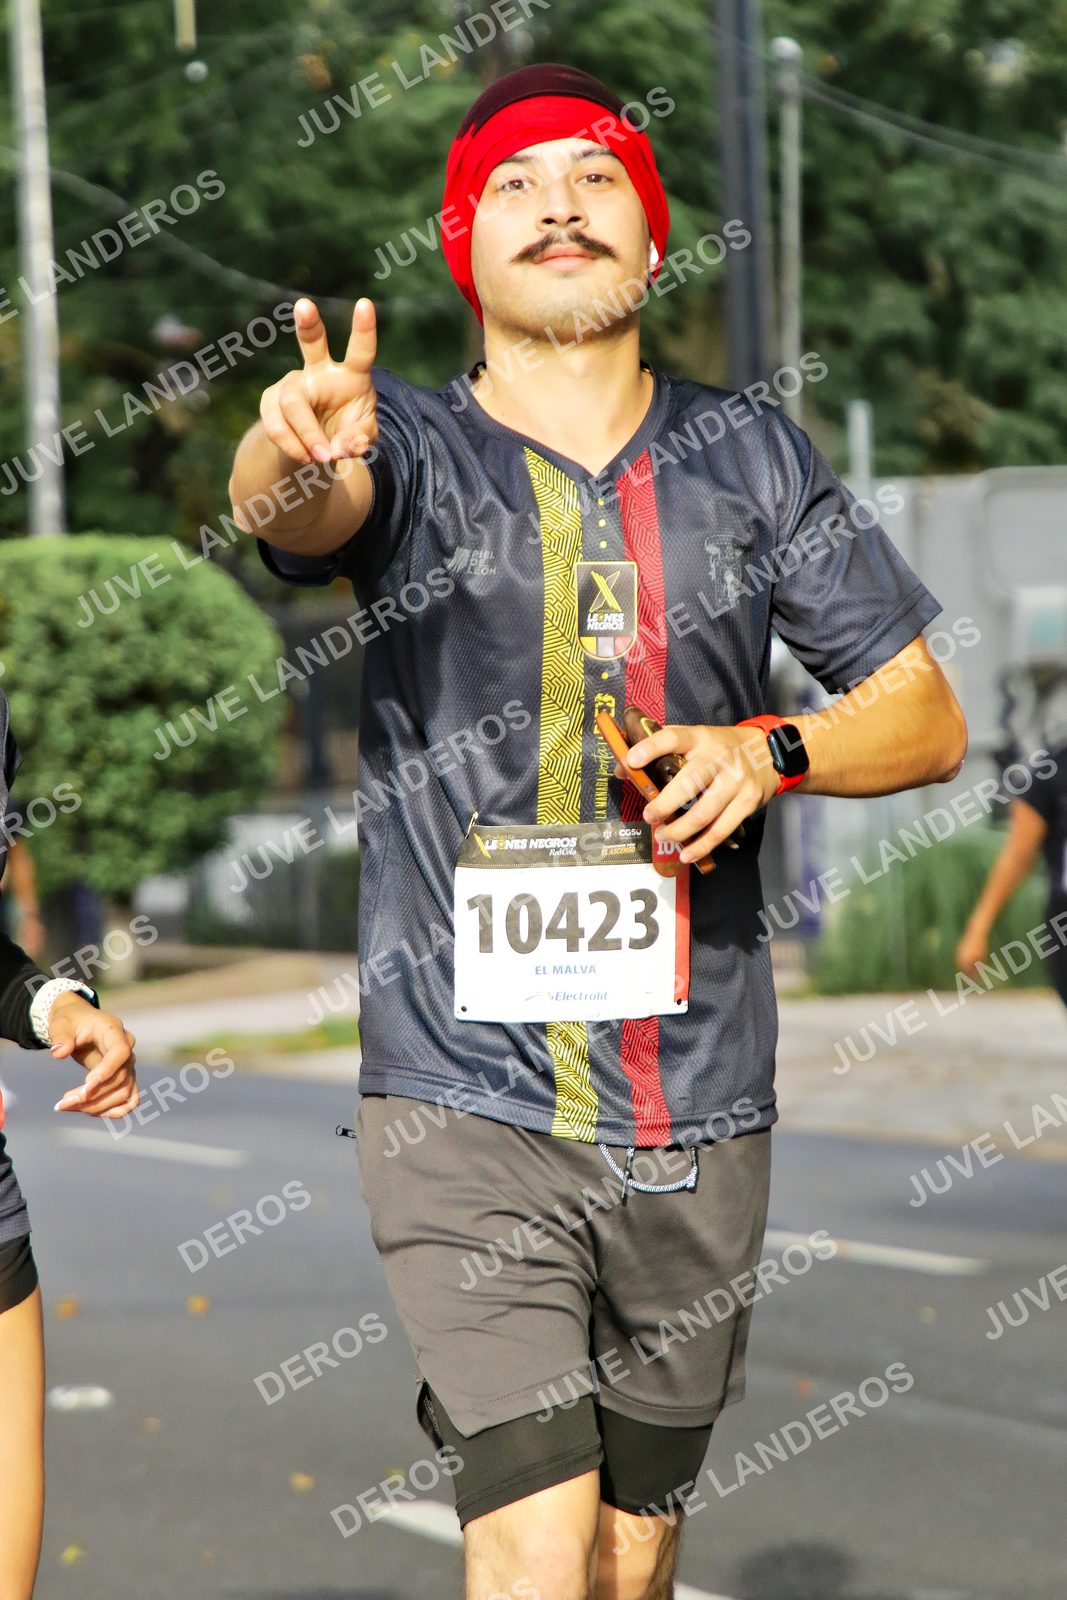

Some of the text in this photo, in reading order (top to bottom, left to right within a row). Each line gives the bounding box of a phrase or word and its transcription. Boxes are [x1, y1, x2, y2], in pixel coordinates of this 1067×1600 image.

[472, 549, 495, 559] PIEL
[470, 558, 486, 567] DE
[587, 613, 625, 623] LEONES
[587, 621, 625, 631] NEGROS
[485, 837, 578, 850] LEONES NEGROS
[466, 888, 660, 954] 10423
[534, 964, 597, 976] EL MALVA
